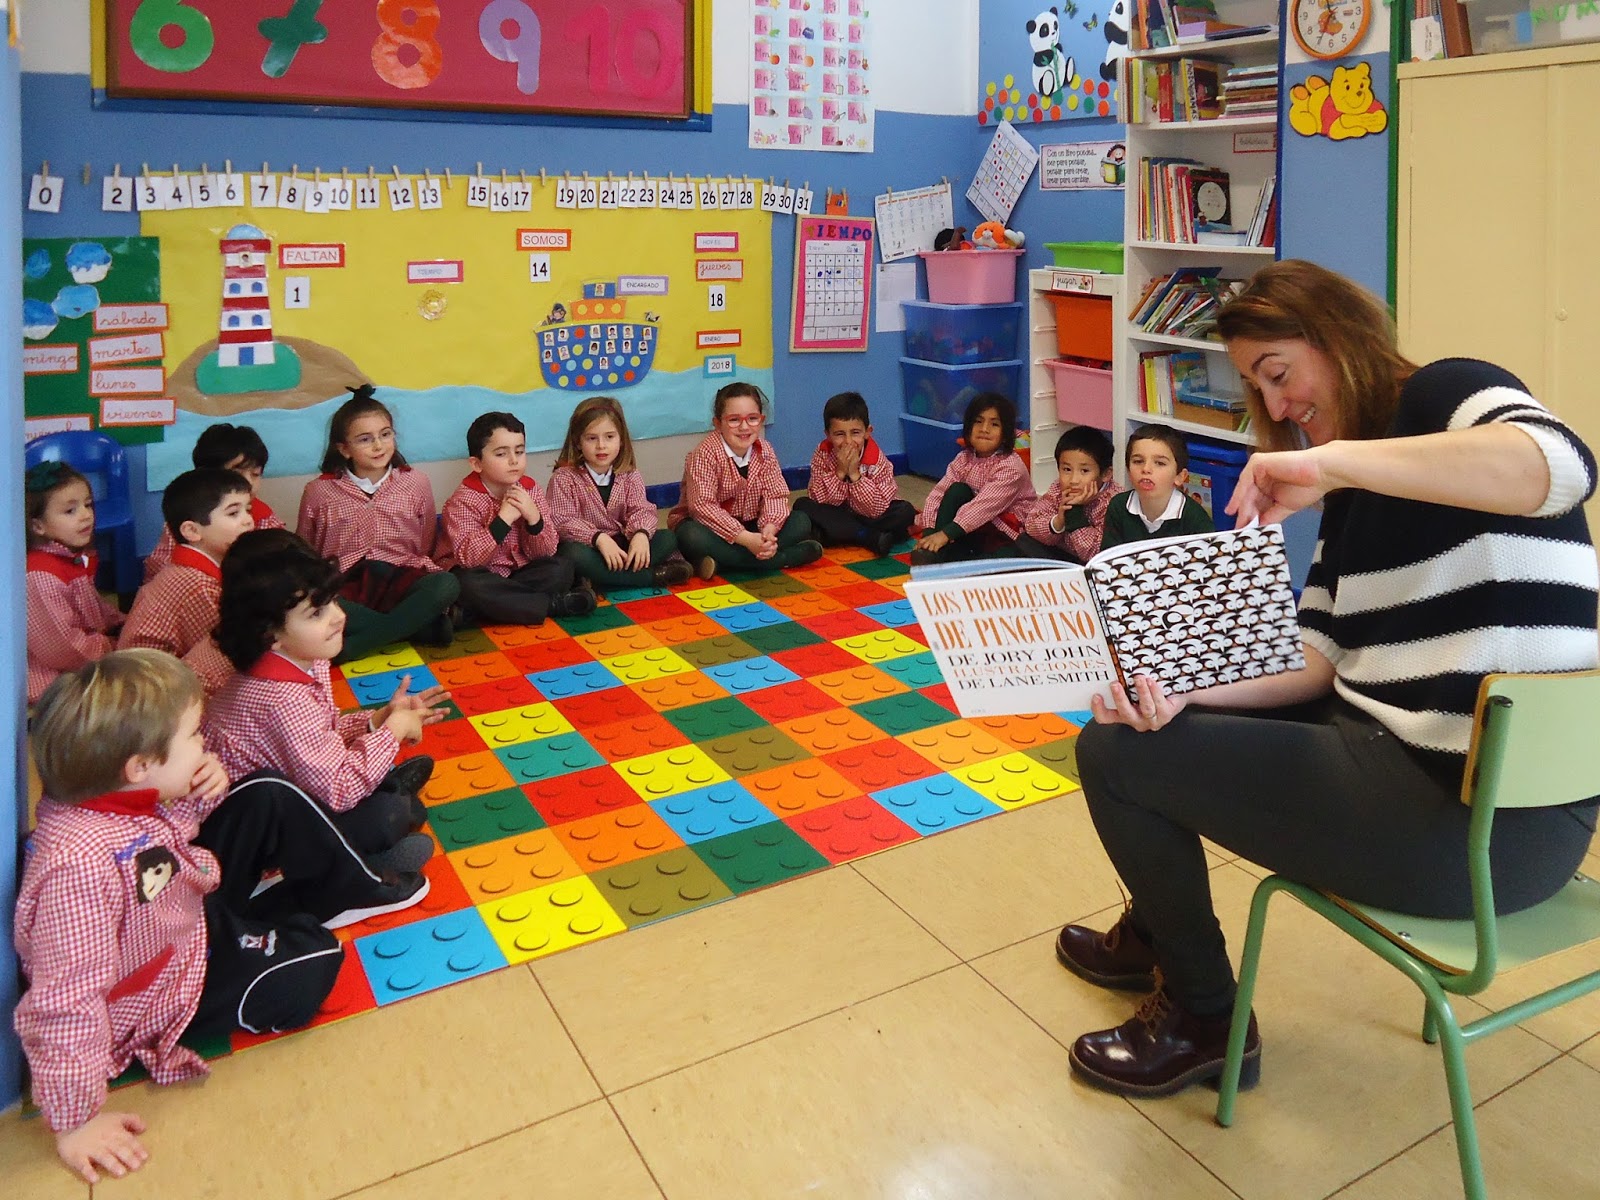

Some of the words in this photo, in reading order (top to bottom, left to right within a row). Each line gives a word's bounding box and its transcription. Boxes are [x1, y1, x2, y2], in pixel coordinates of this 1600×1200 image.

[1303, 12, 1308, 20] 9
[1355, 6, 1361, 15] 3
[1307, 26, 1313, 35] 8
[1350, 21, 1355, 30] 4
[1328, 38, 1334, 48] 6
[1341, 34, 1347, 43] 5
[371, 0, 442, 89] 8
[478, 0, 541, 95] 9
[563, 2, 676, 98] 10
[39, 187, 52, 205] 0
[111, 187, 122, 205] 2
[145, 187, 155, 203] 3
[172, 187, 182, 202] 4
[199, 186, 210, 201] 5
[226, 184, 235, 200] 6
[259, 186, 268, 201] 7
[287, 187, 296, 203] 8
[314, 192, 322, 207] 9
[332, 189, 348, 205] 10
[361, 188, 375, 203] 11
[393, 188, 410, 204] 12
[422, 189, 438, 204] 13
[470, 186, 486, 201] 15
[493, 192, 508, 207] 16
[514, 191, 529, 205] 17
[559, 189, 574, 203] 19
[580, 189, 594, 203] 20
[601, 190, 616, 204] 21
[621, 188, 636, 202] 22
[639, 189, 654, 202] 23
[661, 189, 674, 203] 24
[680, 191, 692, 204] 25
[702, 191, 716, 204] 26
[722, 191, 735, 204] 27
[740, 191, 752, 204] 28
[763, 192, 775, 206] 29
[778, 194, 791, 209] 30
[797, 196, 809, 210] 31
[523, 235, 564, 245] SOMOS
[806, 225, 872, 241] TIEMPO
[286, 250, 337, 261] FALTAN
[533, 262, 547, 277] 14
[700, 264, 731, 276] jueves
[626, 281, 660, 289] ENCARGADO
[1056, 277, 1077, 289] jugar
[294, 287, 300, 302] 1
[711, 293, 723, 307] 18
[100, 311, 157, 326] sábado
[94, 340, 151, 359] martes
[711, 361, 730, 370] 2018
[96, 372, 136, 389] lunes
[106, 410, 164, 419] viernes
[921, 591, 962, 617] LOS
[962, 580, 1086, 614] PROBLEMAS
[934, 619, 973, 651] DE
[973, 609, 1096, 648] PINGÜINO
[948, 653, 978, 668] DE
[984, 649, 1034, 666] JORY
[1044, 644, 1102, 662] JOHN
[953, 658, 1107, 679] ILUSTRACIONES
[959, 678, 985, 690] DE
[989, 674, 1043, 689] LANE
[1048, 670, 1110, 685] SMITH
